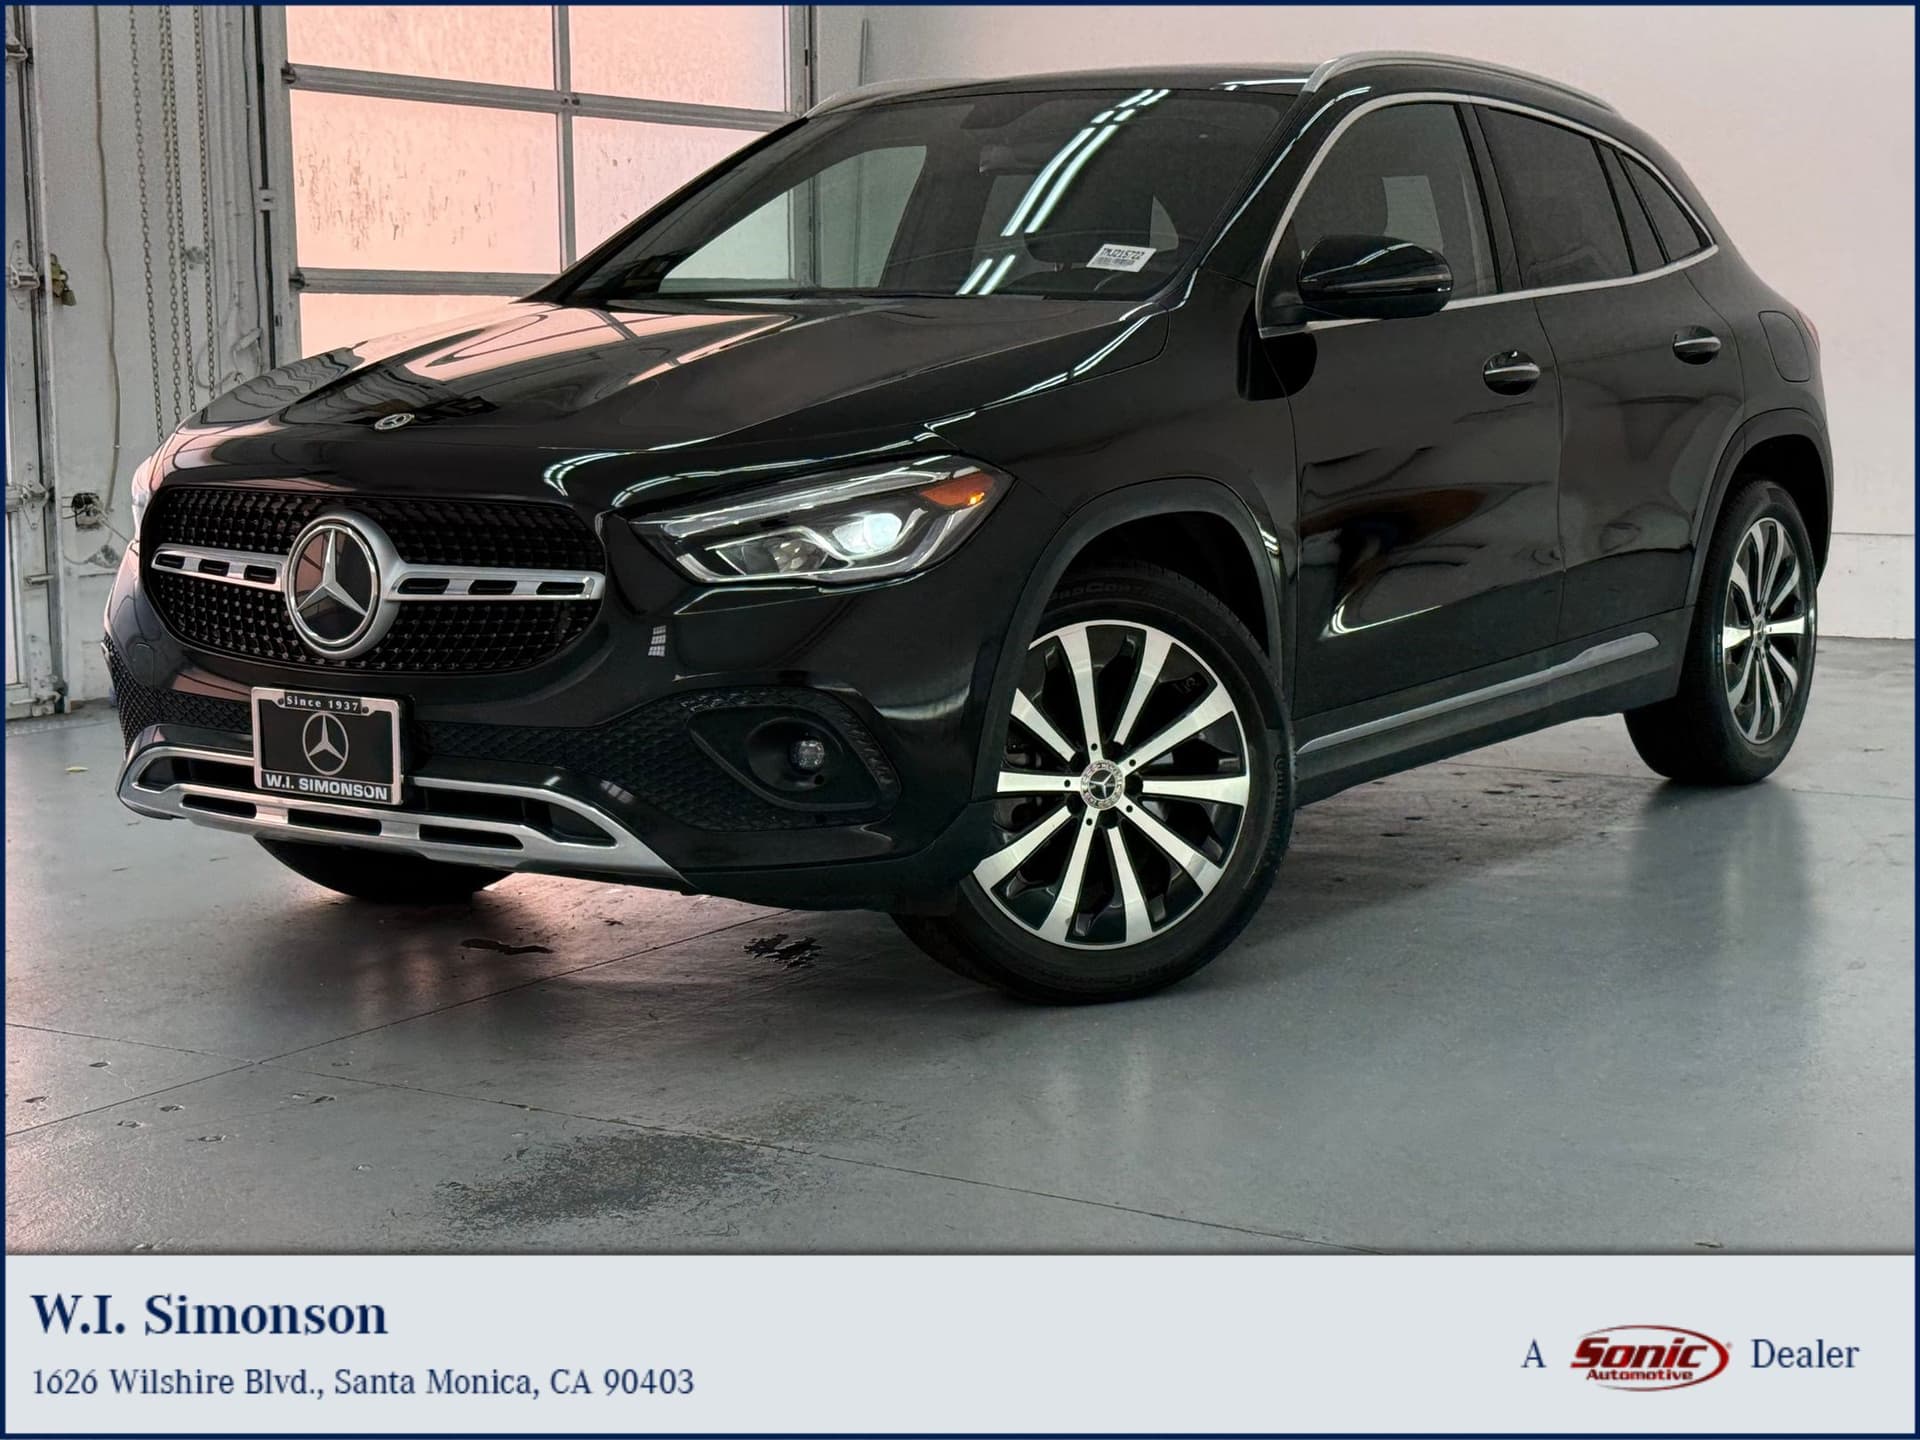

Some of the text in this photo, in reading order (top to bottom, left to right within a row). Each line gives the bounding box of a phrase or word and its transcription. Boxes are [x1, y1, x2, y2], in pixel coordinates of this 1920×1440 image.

[286, 695, 360, 711] Since 1937
[265, 773, 388, 800] W.I. SIMONSON
